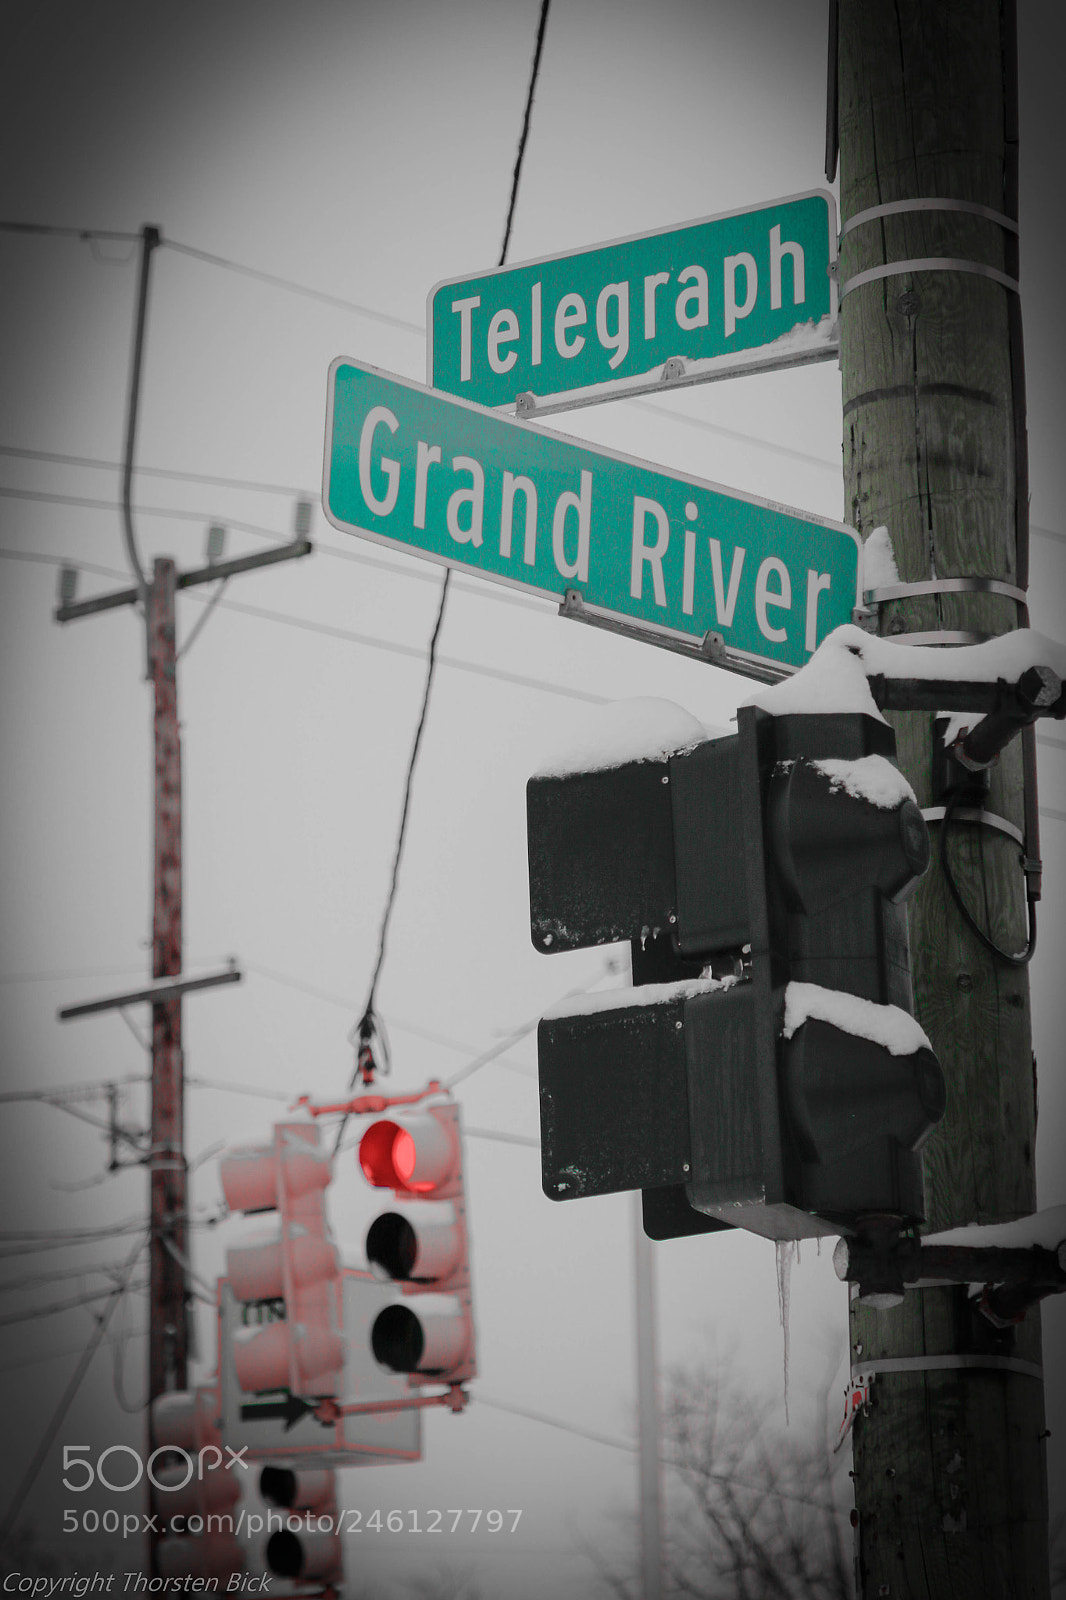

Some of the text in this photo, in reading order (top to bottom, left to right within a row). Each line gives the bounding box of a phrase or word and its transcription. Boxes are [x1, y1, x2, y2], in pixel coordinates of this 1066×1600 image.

[451, 223, 806, 382] Telegraph
[358, 405, 832, 653] Grand River
